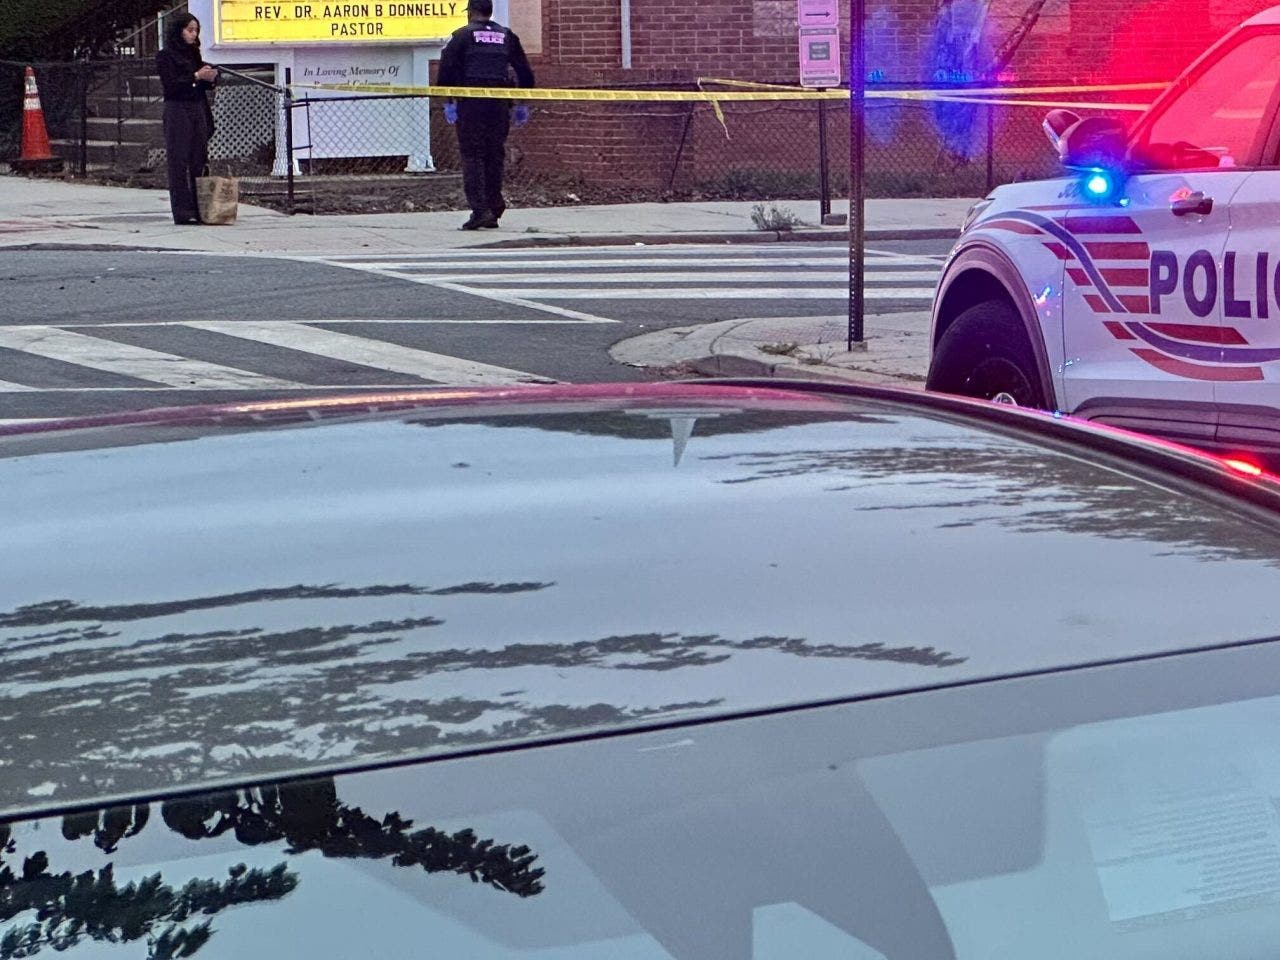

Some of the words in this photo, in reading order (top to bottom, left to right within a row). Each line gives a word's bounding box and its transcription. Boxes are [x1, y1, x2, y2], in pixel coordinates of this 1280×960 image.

[254, 6, 287, 19] REV.
[295, 5, 317, 18] DR.
[323, 5, 369, 18] AARON
[375, 5, 383, 17] B
[389, 3, 457, 17] DONNELLY
[331, 23, 384, 36] PASTOR
[303, 67, 314, 77] In
[316, 67, 347, 77] Loving
[349, 66, 386, 77] Memory
[388, 65, 401, 77] Of
